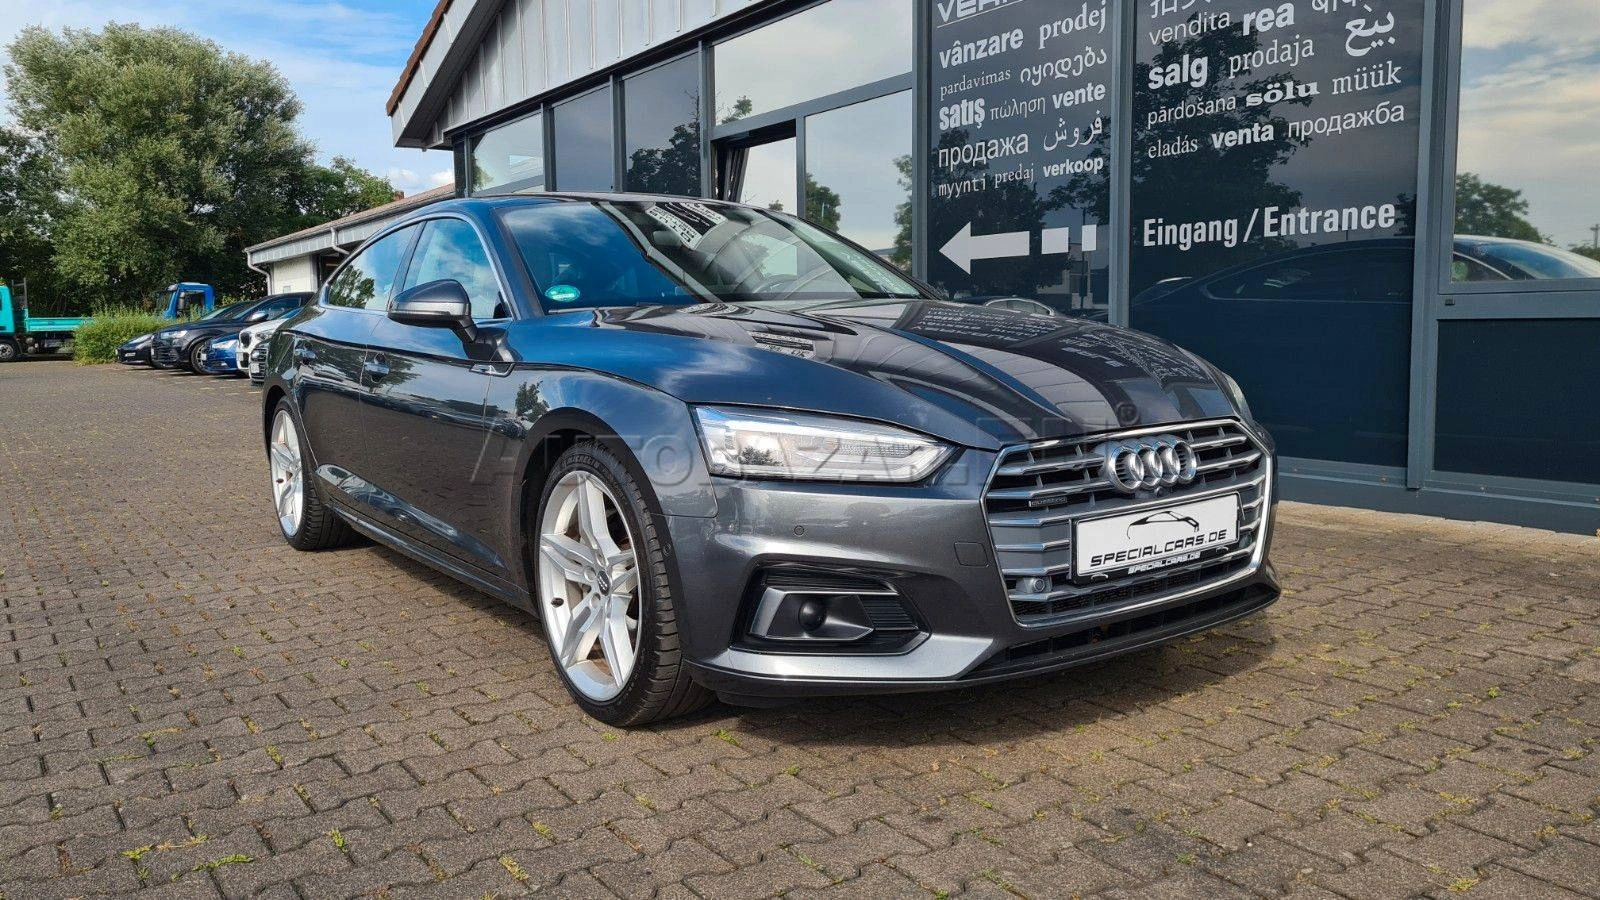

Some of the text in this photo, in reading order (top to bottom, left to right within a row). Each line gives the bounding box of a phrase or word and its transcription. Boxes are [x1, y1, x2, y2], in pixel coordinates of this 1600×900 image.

[939, 28, 1024, 69] vânzare
[1038, 0, 1106, 50] prodej
[1149, 11, 1231, 46] vendita
[1242, 2, 1295, 37] rea
[1148, 34, 1315, 89] salg prodaja
[940, 69, 1011, 101] pardavimas
[1052, 83, 1106, 109] vente
[1147, 60, 1402, 129] pārdošana sölu müük
[939, 98, 986, 130] satış
[990, 96, 1046, 120] πώληση
[1287, 101, 1405, 141] продажба
[938, 133, 1029, 172] продажа
[1147, 124, 1275, 159] eladás venta
[938, 156, 1104, 199] myynti predaj verkoop
[1143, 218, 1238, 251] Eingang
[1263, 203, 1396, 238] Entrance
[1090, 529, 1227, 567] SPECIALCARS.DE
